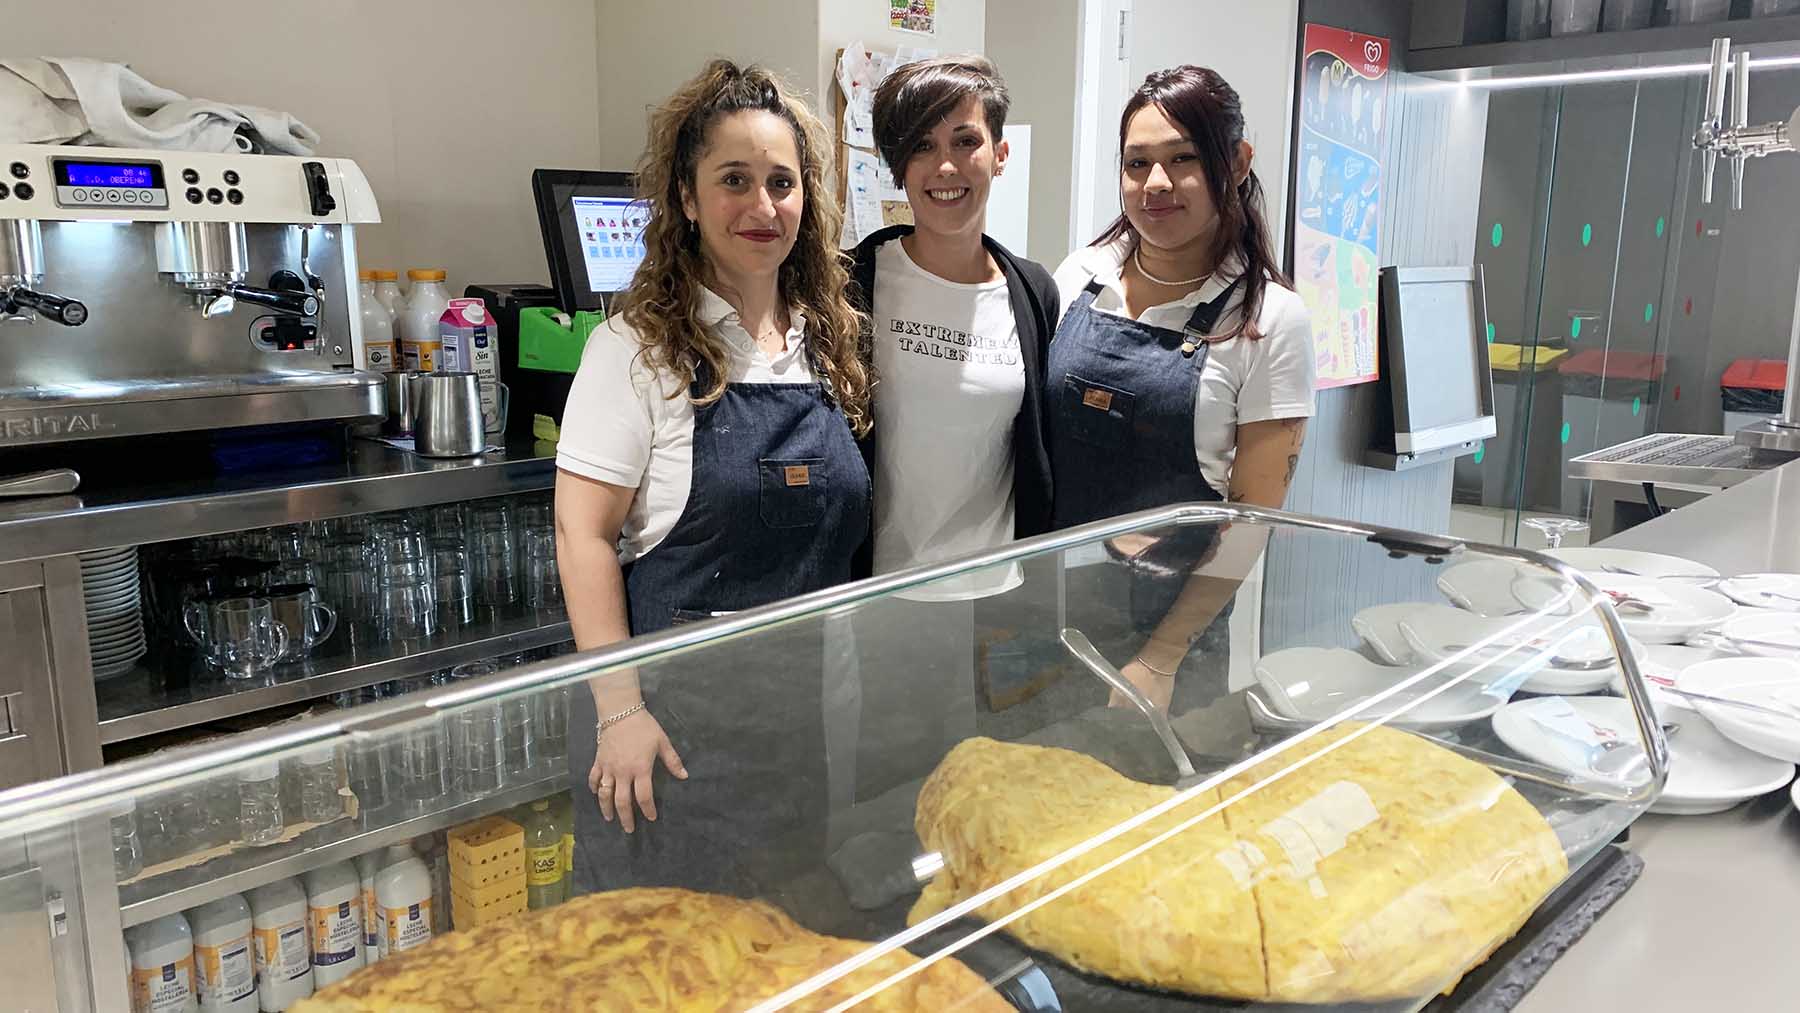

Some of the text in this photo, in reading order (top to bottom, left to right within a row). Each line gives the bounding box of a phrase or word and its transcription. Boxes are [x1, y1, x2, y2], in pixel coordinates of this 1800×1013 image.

[1363, 63, 1380, 74] FRIGO
[110, 176, 145, 185] OBERENA
[475, 351, 489, 361] Sin
[899, 338, 1017, 366] TALENTED
[0, 413, 116, 438] RITAL
[534, 857, 555, 868] KAS
